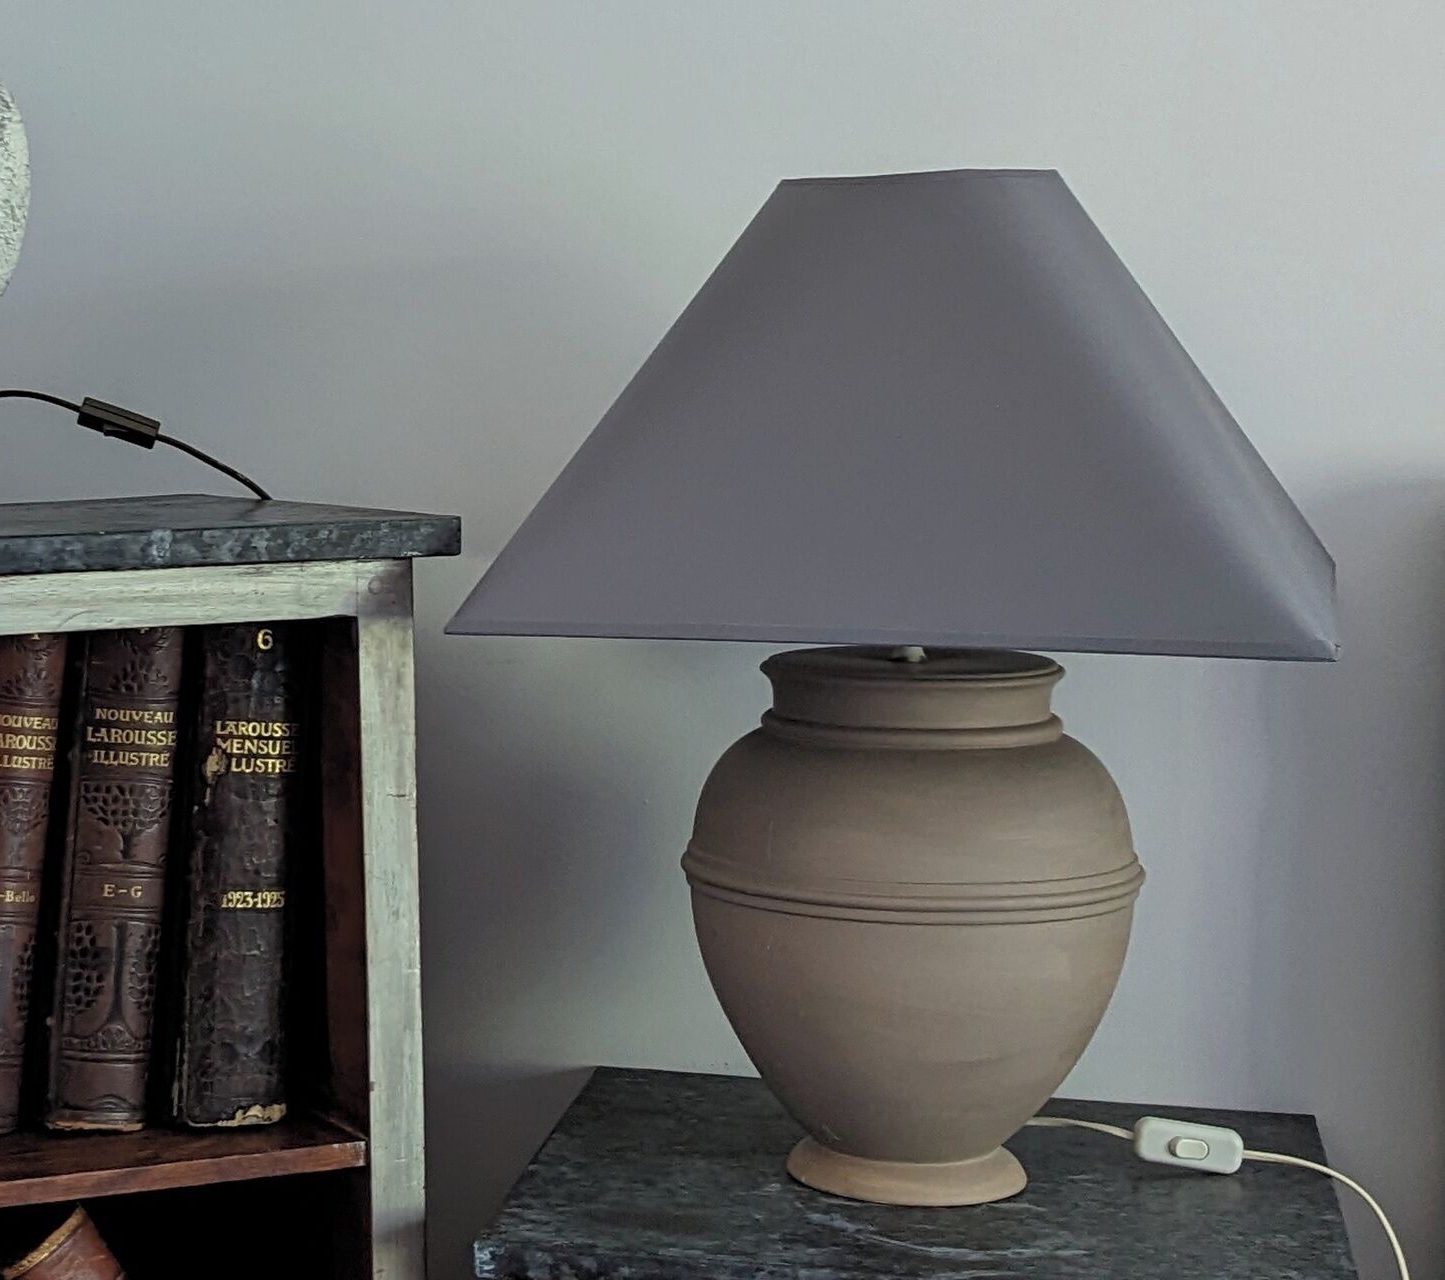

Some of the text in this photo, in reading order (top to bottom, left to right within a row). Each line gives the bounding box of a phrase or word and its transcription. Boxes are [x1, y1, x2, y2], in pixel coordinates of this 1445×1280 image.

[257, 628, 274, 650] 6
[95, 708, 175, 724] NOUVEAU
[86, 725, 178, 747] LAROUSSE
[216, 720, 299, 737] LAROUSSE
[216, 737, 296, 755] MENSUEL
[221, 891, 286, 908] 1923-1925
